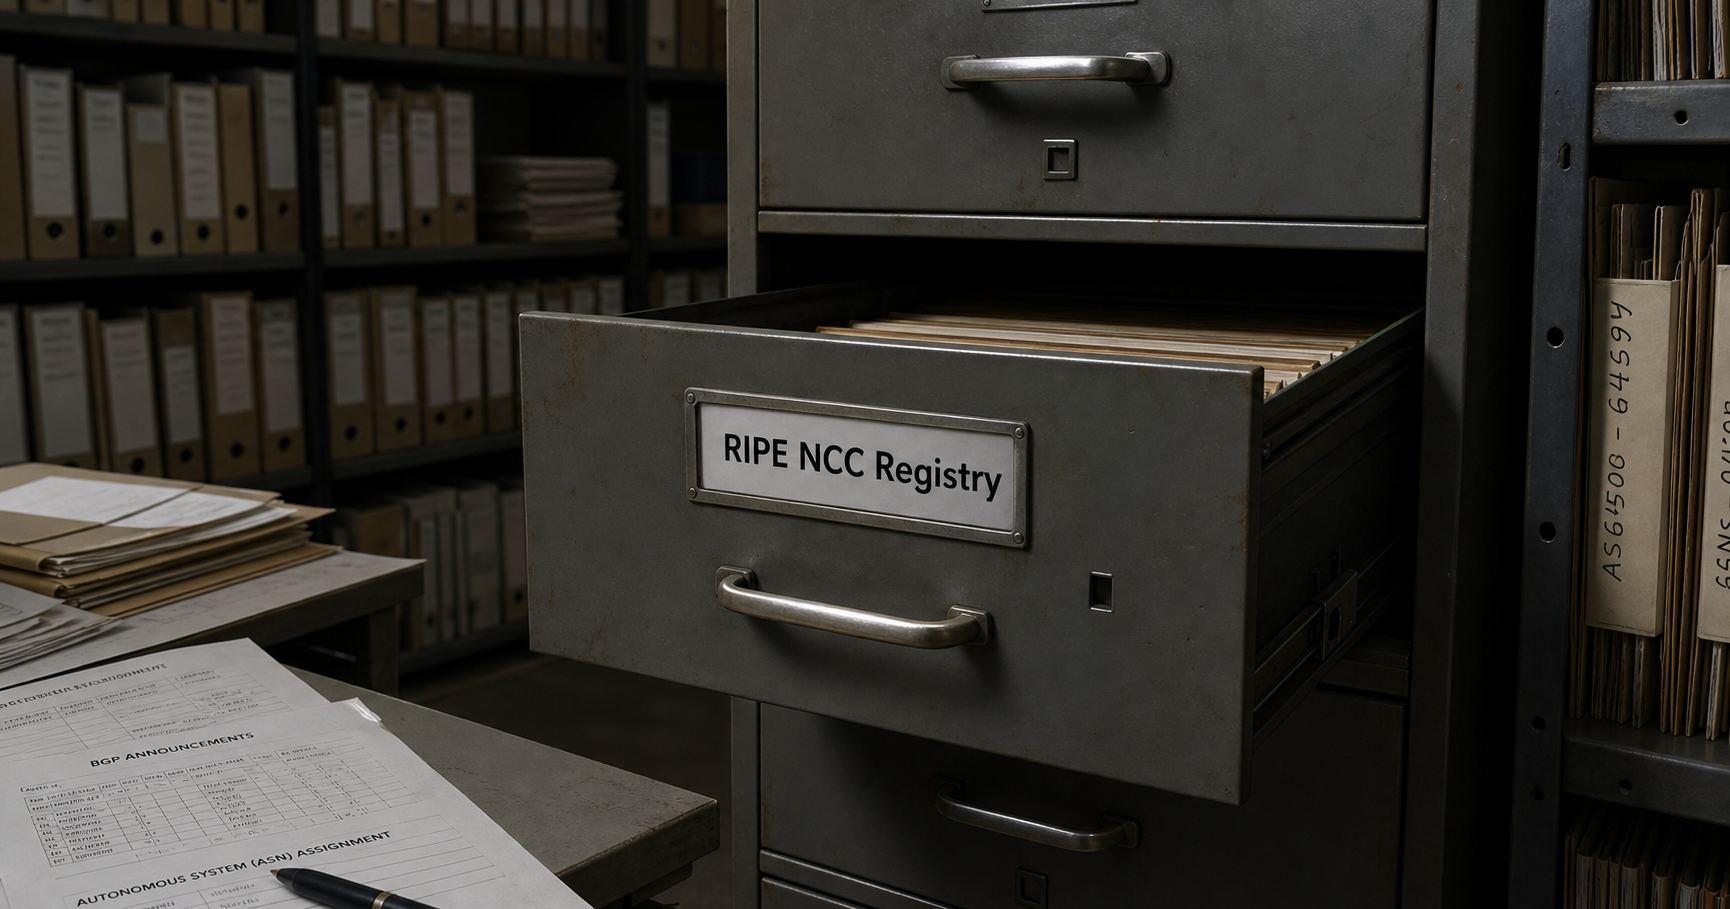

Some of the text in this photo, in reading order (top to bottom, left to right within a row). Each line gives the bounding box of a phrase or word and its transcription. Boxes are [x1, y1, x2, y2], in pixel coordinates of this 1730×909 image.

[724, 433, 1003, 502] RIPE NCC Registry
[90, 755, 121, 768] BGP
[125, 731, 254, 761] ANNOUNCEMENTS
[76, 875, 187, 907] AUTONOMOUS
[190, 861, 248, 881] SYSTEM
[250, 851, 293, 868] (ASN)
[296, 830, 392, 858] ASSIGNMENT
